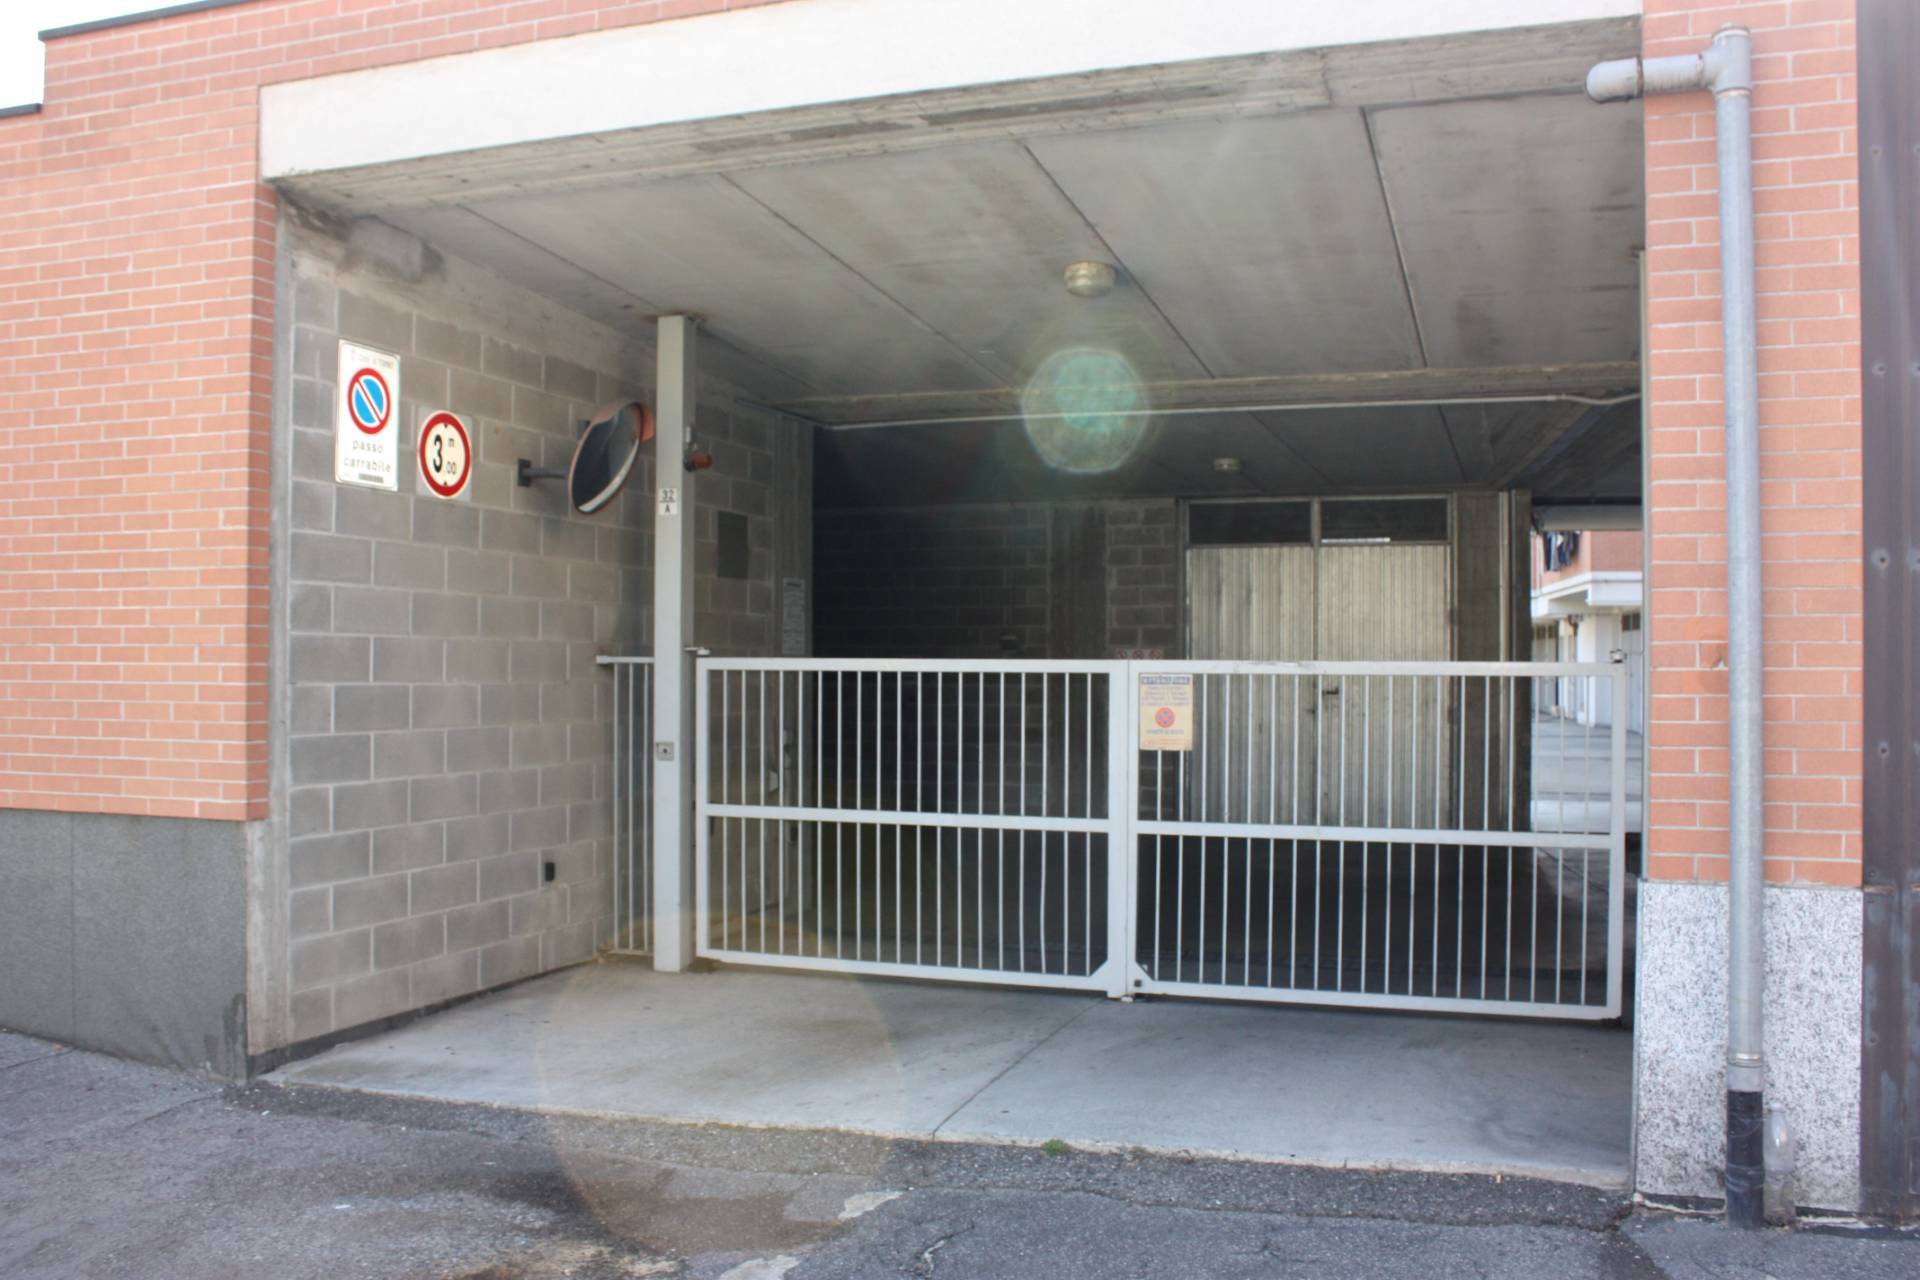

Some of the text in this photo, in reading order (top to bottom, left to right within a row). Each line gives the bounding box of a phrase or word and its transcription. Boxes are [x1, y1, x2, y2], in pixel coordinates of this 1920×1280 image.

[352, 439, 384, 454] passo
[433, 434, 443, 473] 3
[343, 457, 391, 473] carrabile
[664, 503, 670, 513] A
